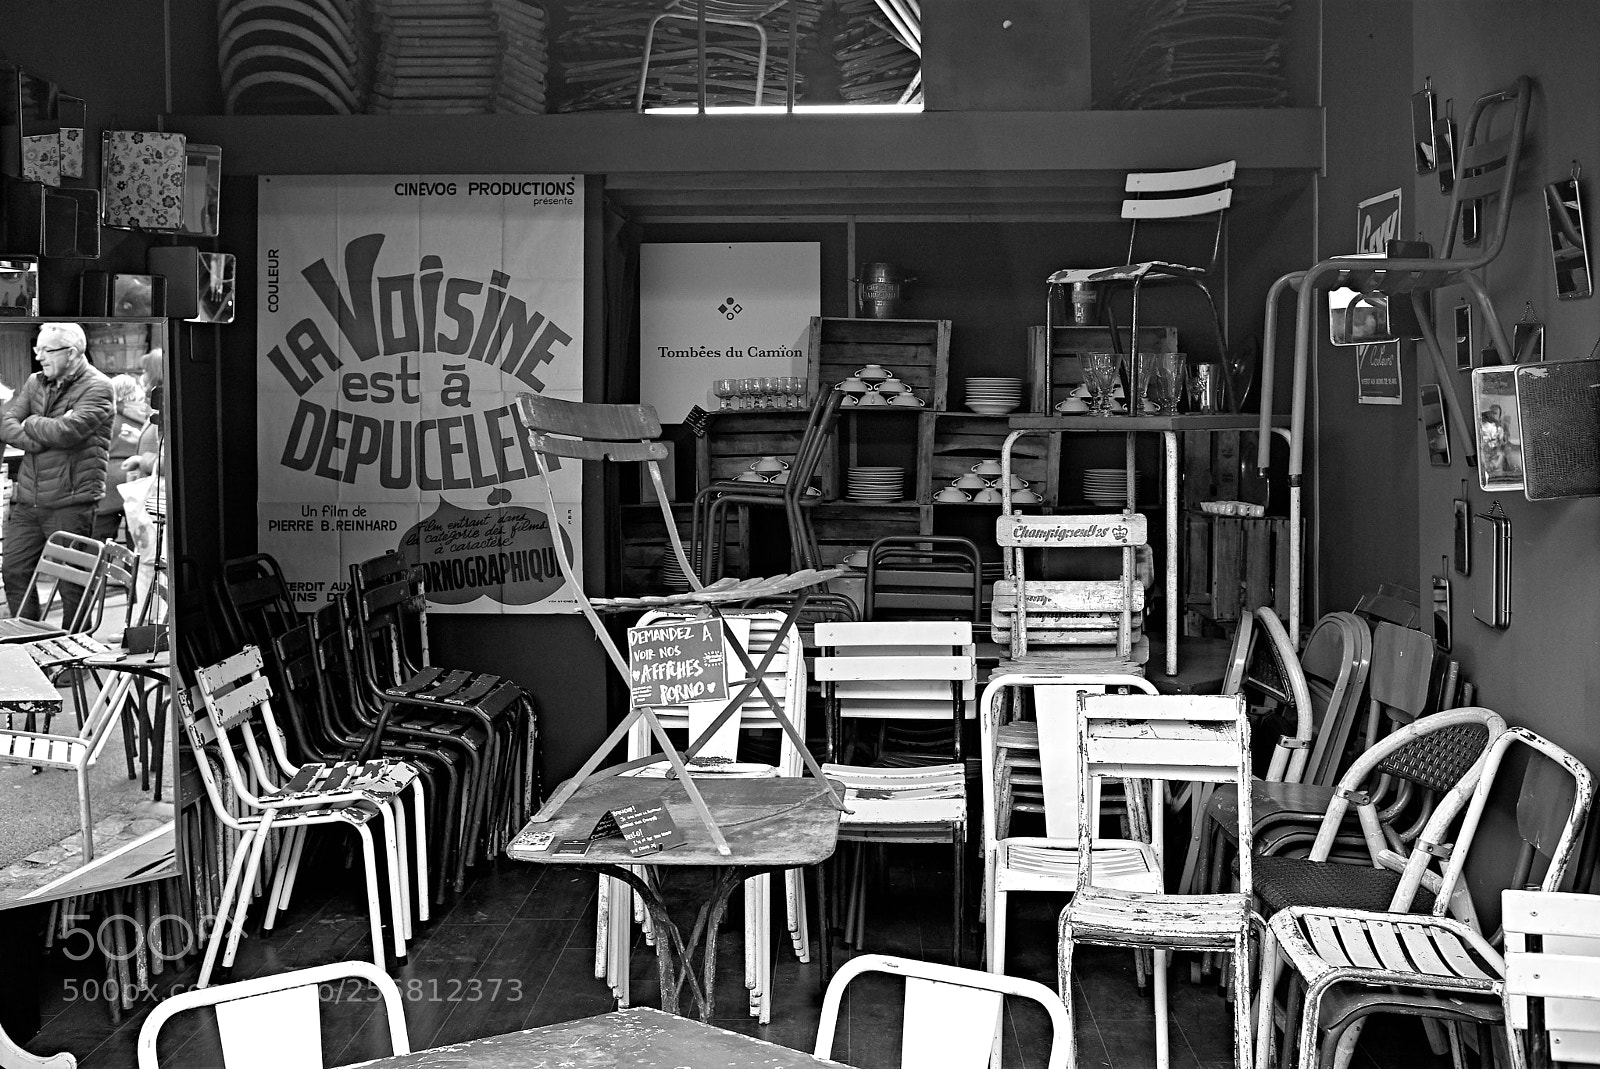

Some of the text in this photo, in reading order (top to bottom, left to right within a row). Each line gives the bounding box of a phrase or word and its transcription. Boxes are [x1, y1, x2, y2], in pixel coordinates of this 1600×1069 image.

[468, 181, 575, 196] PRODUCTIONS
[533, 197, 573, 207] présente
[268, 248, 279, 313] COULEUR
[267, 318, 344, 397] LA
[725, 347, 743, 358] du
[342, 355, 421, 404] est
[301, 504, 367, 518] Un film de
[268, 520, 314, 532] PIERRE
[510, 518, 548, 538] films
[410, 546, 564, 593] ORNOGRAPHIQU
[629, 624, 713, 647] DEMANDEZ A
[633, 645, 681, 662] VOIR NOS
[640, 658, 704, 685] AFFICHES
[659, 681, 705, 706] PORNO
